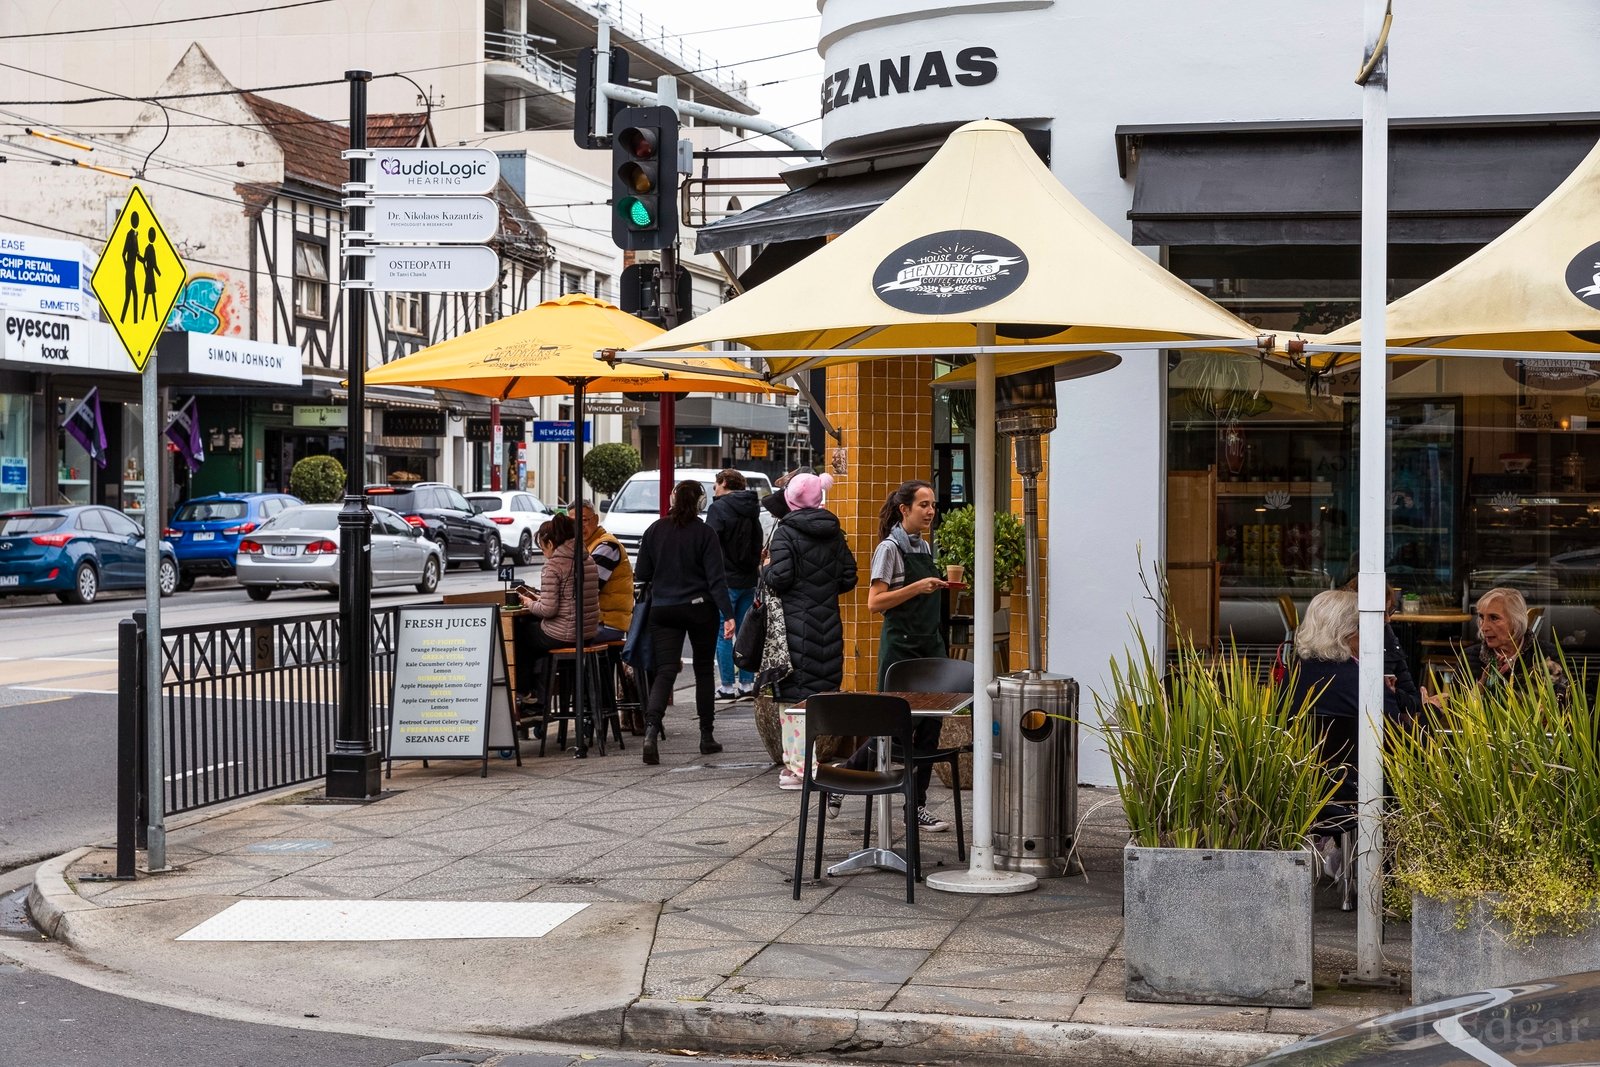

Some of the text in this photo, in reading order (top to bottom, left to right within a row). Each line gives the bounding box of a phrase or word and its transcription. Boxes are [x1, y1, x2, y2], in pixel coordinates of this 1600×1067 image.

[388, 211, 484, 220] Dr. Nikolaos Kazantzis
[0, 238, 25, 251] EASE
[920, 253, 951, 264] HOUSE
[24, 260, 54, 272] RETAIL
[389, 260, 451, 270] OSTEOPATH
[18, 270, 60, 284] LOCATION
[902, 263, 995, 280] HENDRICKS
[955, 274, 997, 284] ROASTERS
[40, 299, 80, 312] EMMETTS
[6, 316, 70, 342] eyescan
[41, 344, 69, 360] toorak
[208, 347, 282, 368] SIMON JOHNSON
[540, 428, 575, 437] NEWSAGEN
[500, 568, 512, 579] 41
[405, 617, 487, 629] FRESH JUICES
[405, 735, 470, 743] SEZANAS CAFE
